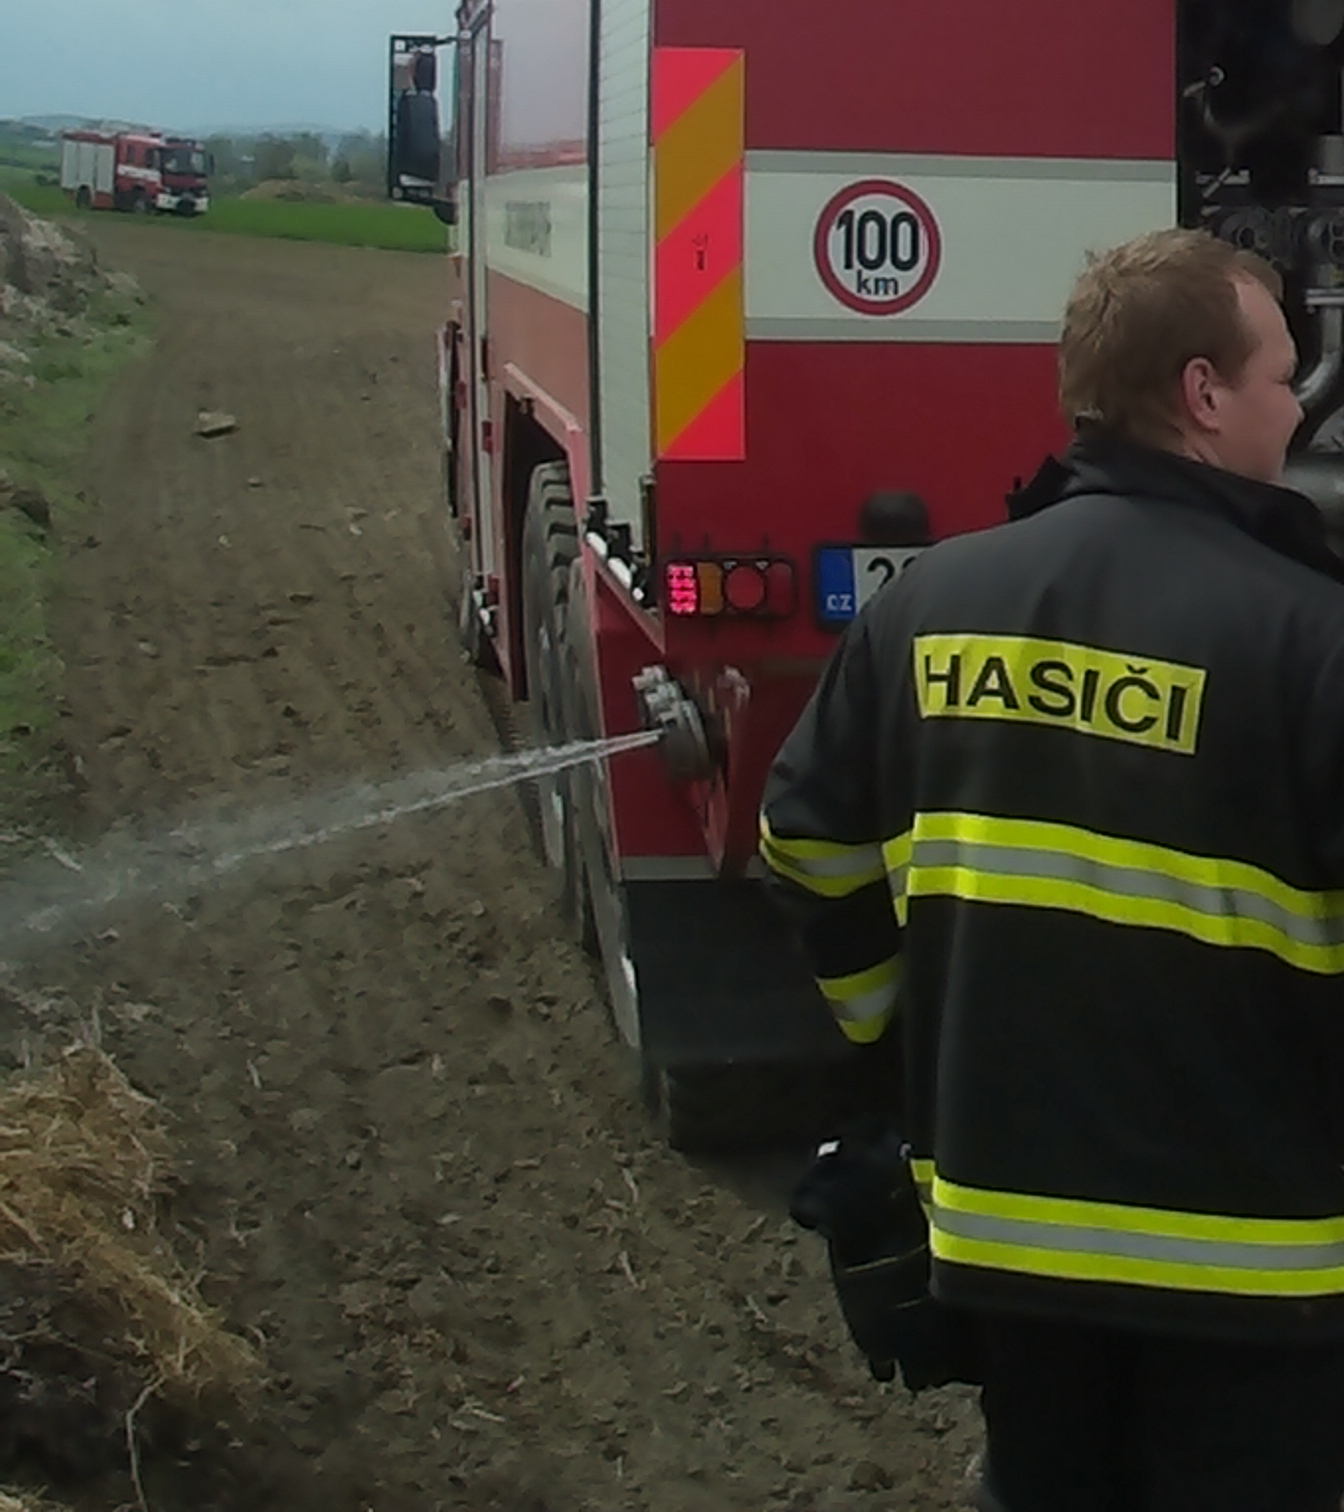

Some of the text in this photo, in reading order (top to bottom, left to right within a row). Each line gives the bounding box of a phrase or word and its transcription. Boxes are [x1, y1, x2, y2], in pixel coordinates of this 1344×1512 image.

[836, 209, 920, 272] 100
[856, 268, 899, 296] km
[826, 594, 853, 611] CZ
[924, 654, 1188, 742] HASIČI
